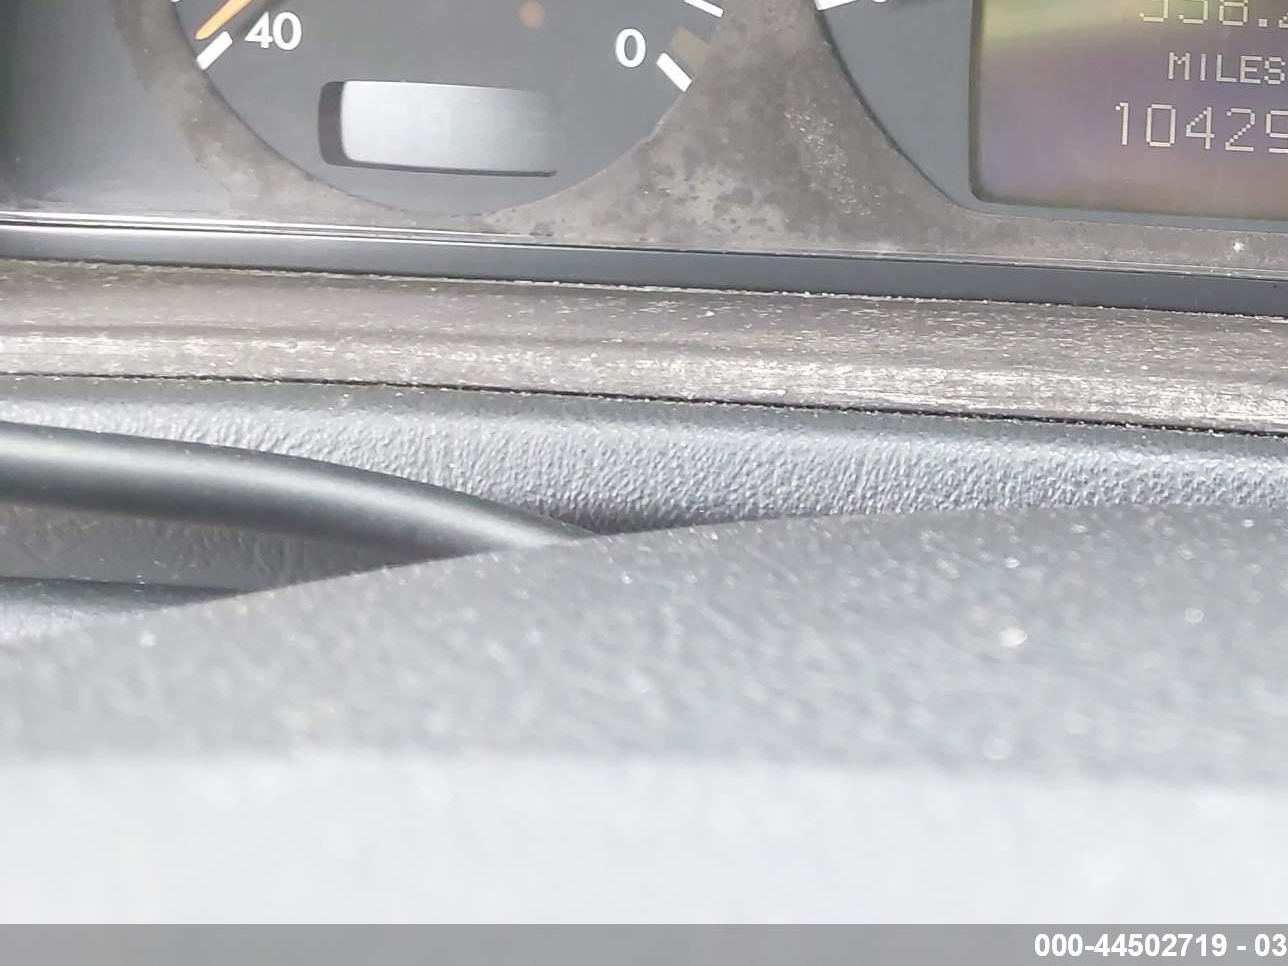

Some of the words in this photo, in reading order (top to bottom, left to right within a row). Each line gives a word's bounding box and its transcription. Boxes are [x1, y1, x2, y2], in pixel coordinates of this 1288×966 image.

[245, 12, 303, 51] 40
[615, 28, 647, 68] 0
[1168, 51, 1286, 86] MILES
